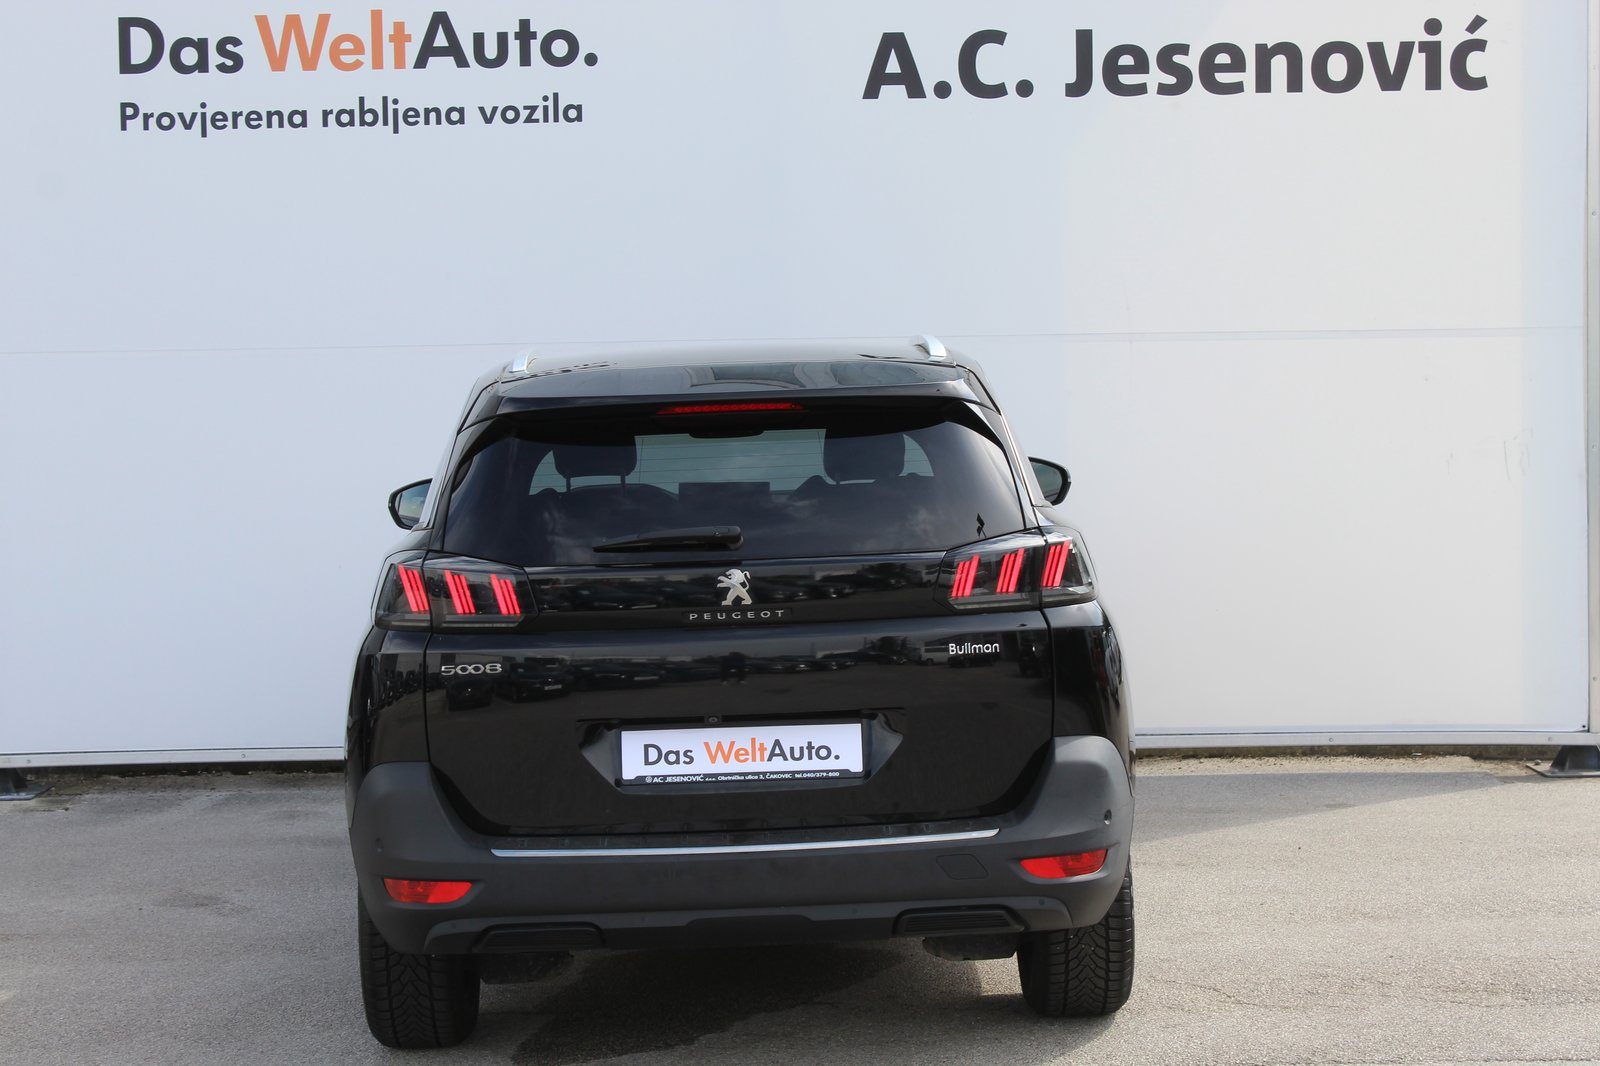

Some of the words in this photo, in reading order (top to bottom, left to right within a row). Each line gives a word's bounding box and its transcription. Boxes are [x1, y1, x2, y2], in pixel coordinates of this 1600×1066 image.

[117, 16, 244, 75] Das
[255, 9, 599, 73] WeltAuto.
[862, 29, 1035, 100] A.C.
[1065, 14, 1488, 98] Jesenović
[119, 101, 308, 138] Provjerena
[321, 95, 466, 134] rabljena
[477, 92, 584, 125] vozila
[689, 609, 785, 620] PEUGEOT
[948, 642, 1000, 655] Bullman
[441, 663, 503, 676] 5008
[643, 743, 695, 766] Das
[665, 774, 705, 783] JESENOVIĆ
